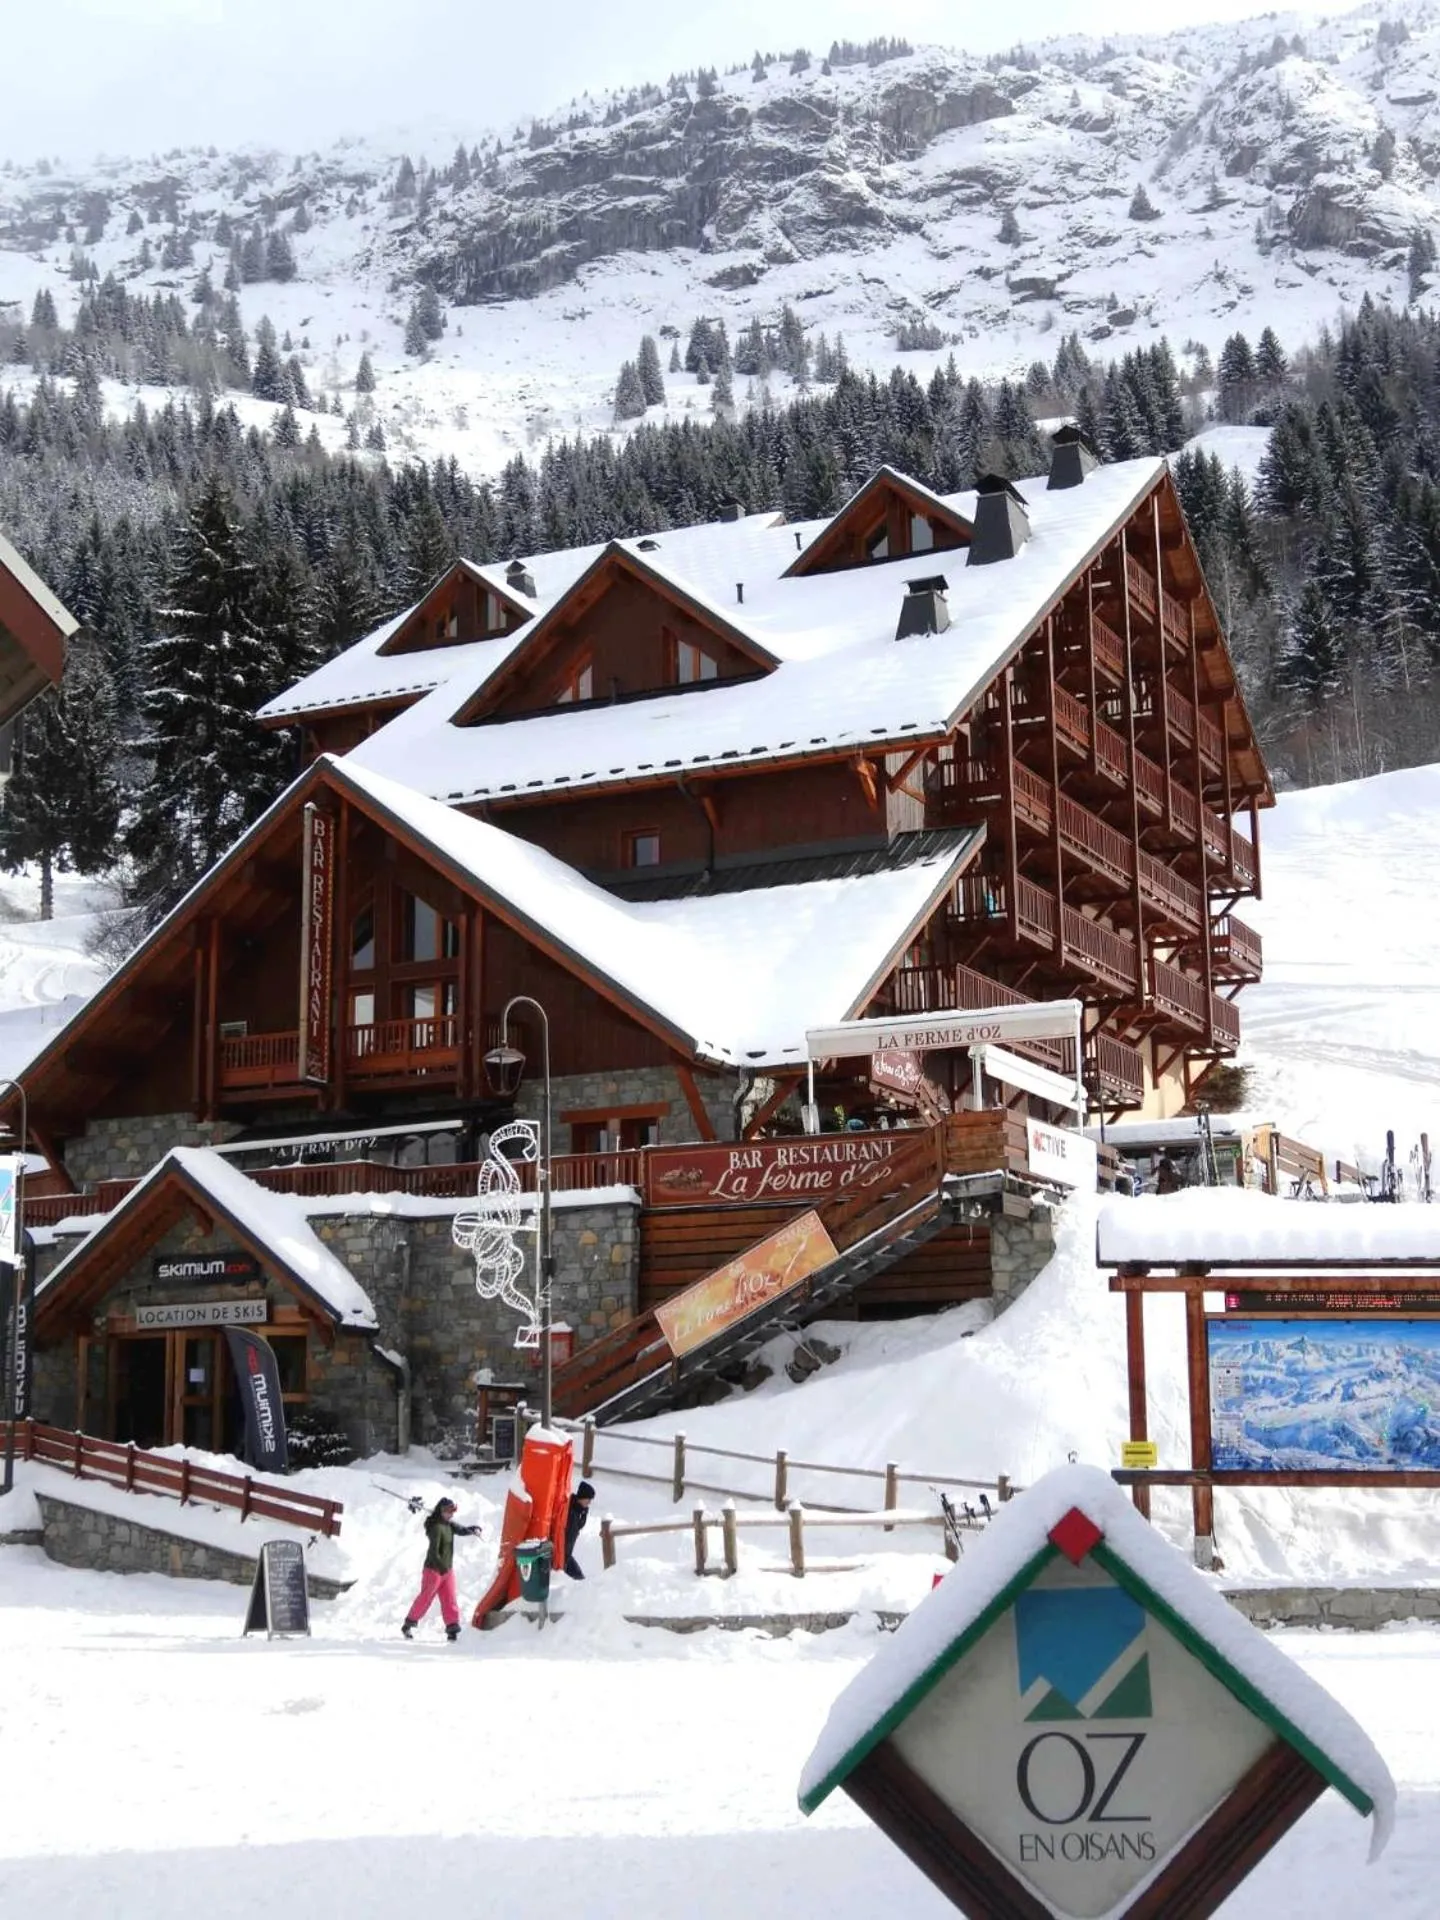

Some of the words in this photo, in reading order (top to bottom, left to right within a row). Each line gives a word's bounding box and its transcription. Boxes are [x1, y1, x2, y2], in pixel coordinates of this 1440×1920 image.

[313, 819, 325, 869] BAR
[311, 874, 324, 1037] RESTAURANT
[878, 1036, 898, 1049] LA
[904, 1030, 962, 1047] FERME
[967, 1026, 1001, 1040] d'OZ
[729, 1150, 763, 1169] BAR
[777, 1140, 896, 1168] RESTAURANT
[708, 1168, 748, 1199] La
[743, 1160, 833, 1200] ferme
[138, 1309, 206, 1324] LOCATION
[212, 1307, 229, 1319] DE
[234, 1305, 264, 1318] SKIS
[1016, 1732, 1151, 1824] OZ
[1019, 1833, 1055, 1862] EN
[1061, 1831, 1156, 1862] OISANS
